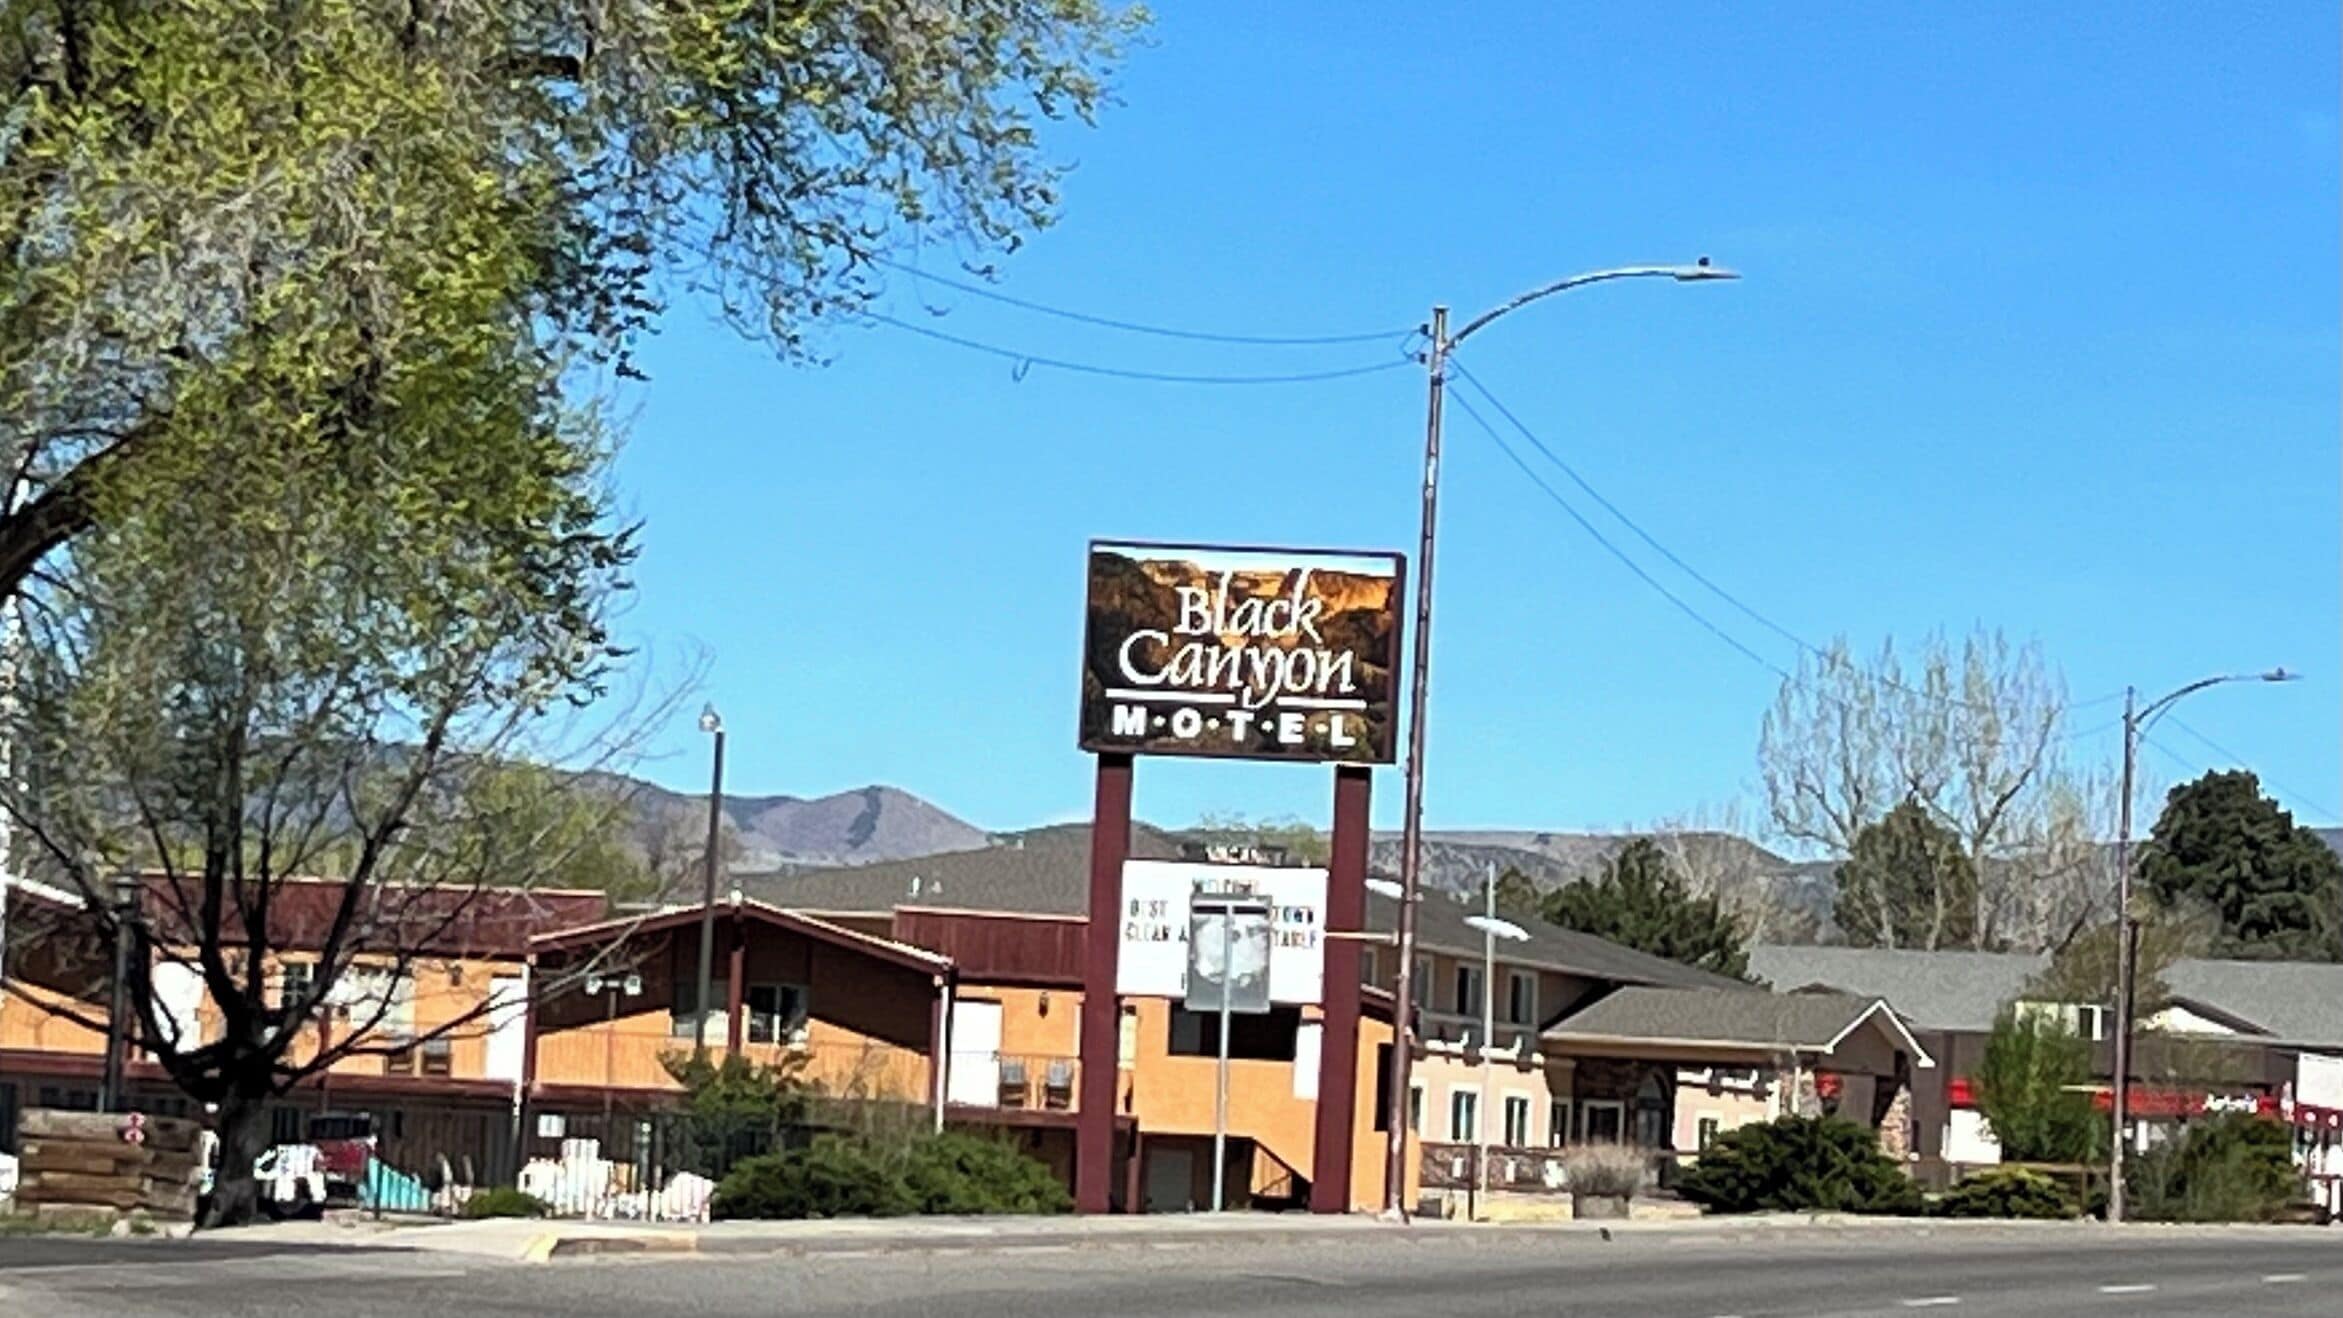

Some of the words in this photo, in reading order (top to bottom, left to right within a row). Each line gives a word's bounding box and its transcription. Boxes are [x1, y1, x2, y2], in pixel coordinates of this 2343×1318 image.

[1173, 567, 1325, 643] Black
[1118, 629, 1356, 709] Canyon
[1125, 922, 1171, 943] CLEAN
